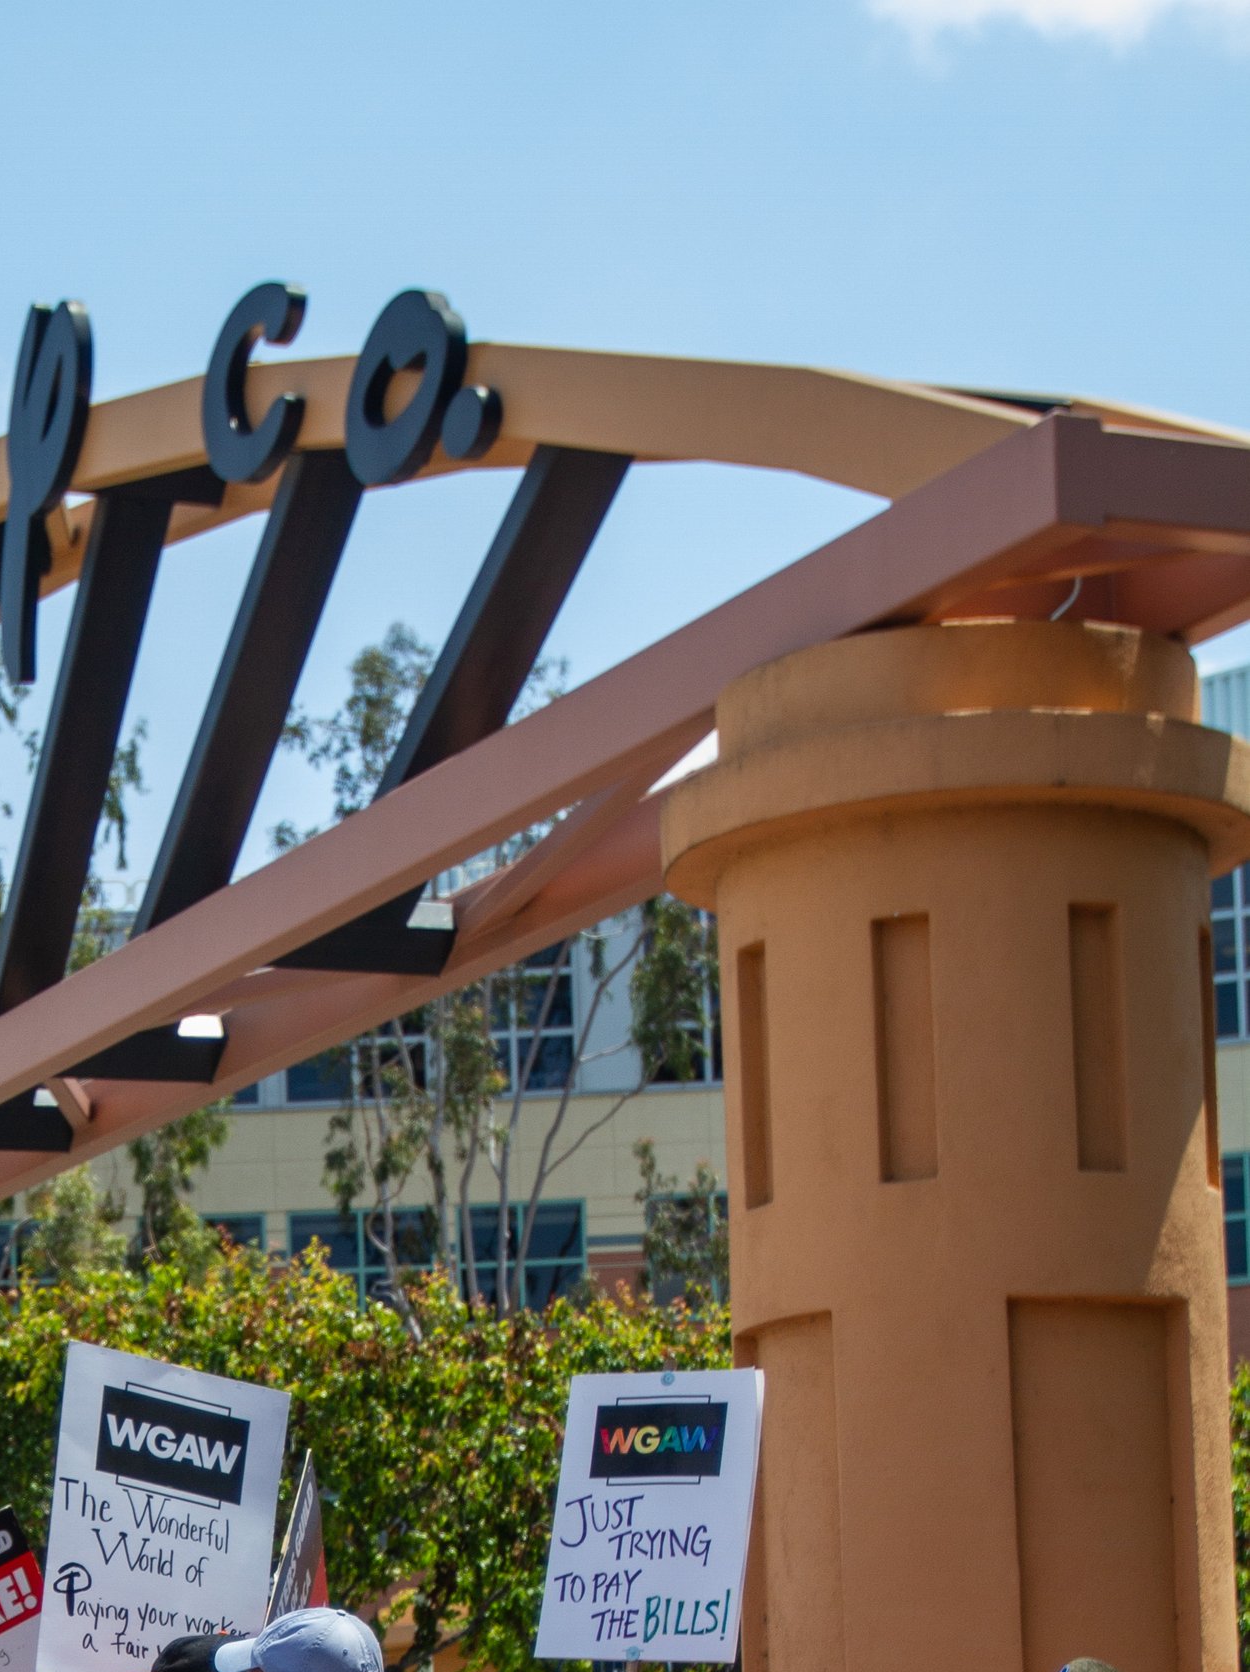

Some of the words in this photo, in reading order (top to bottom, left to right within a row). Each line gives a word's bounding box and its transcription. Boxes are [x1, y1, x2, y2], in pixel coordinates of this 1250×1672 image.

[106, 1412, 242, 1476] WGAW
[599, 1424, 720, 1456] WGAW
[59, 1477, 114, 1523] The
[122, 1488, 231, 1554] Wonderful
[559, 1493, 645, 1548] JUST
[90, 1527, 174, 1579] World
[185, 1555, 210, 1588] of
[608, 1524, 712, 1567] TRYING
[52, 1561, 130, 1632] Paying
[137, 1602, 180, 1632] your
[554, 1571, 586, 1603] TO
[590, 1568, 643, 1604] PAY
[82, 1633, 99, 1653] a
[591, 1607, 640, 1642] THE
[642, 1588, 732, 1643] BILLS!
